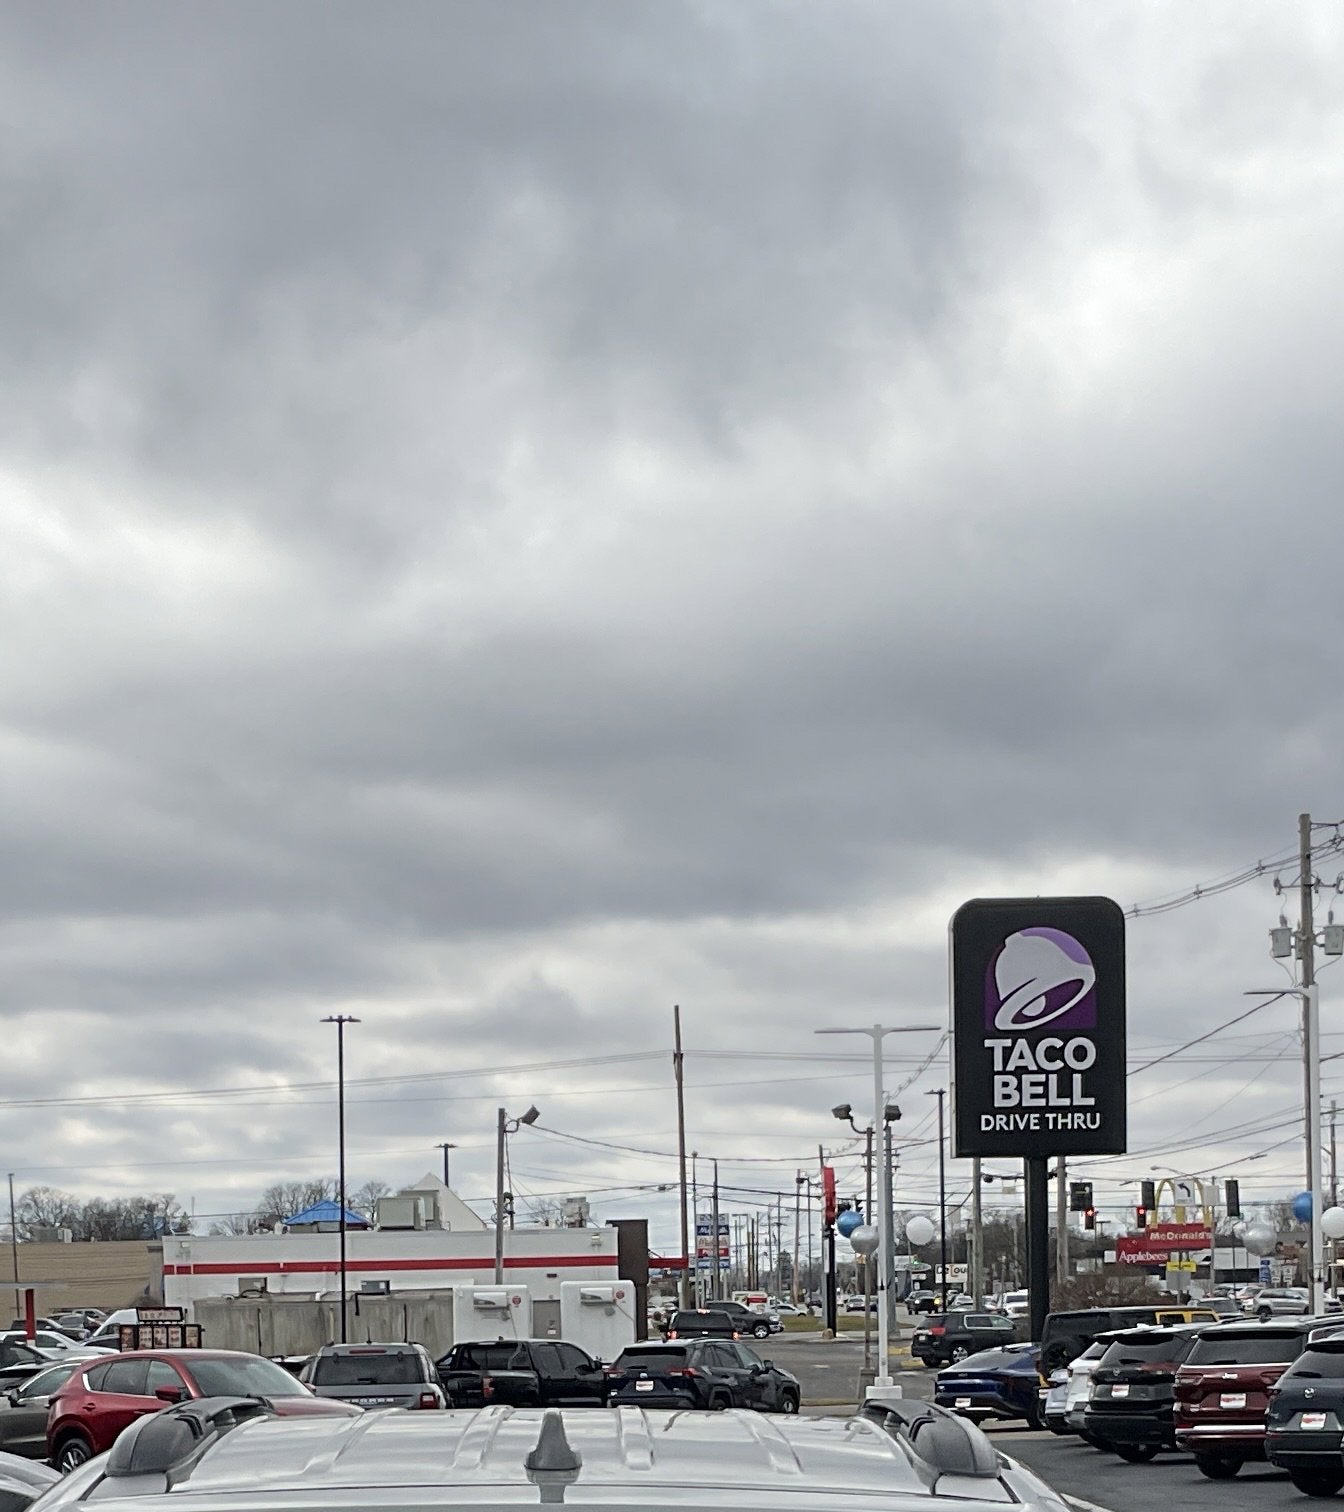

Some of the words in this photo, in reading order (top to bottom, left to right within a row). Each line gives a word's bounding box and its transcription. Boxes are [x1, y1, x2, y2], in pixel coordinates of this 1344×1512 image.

[984, 1037, 1097, 1072] TACO
[993, 1073, 1095, 1108] BELL
[981, 1113, 1040, 1131] DRIVE
[1045, 1112, 1101, 1130] THRU
